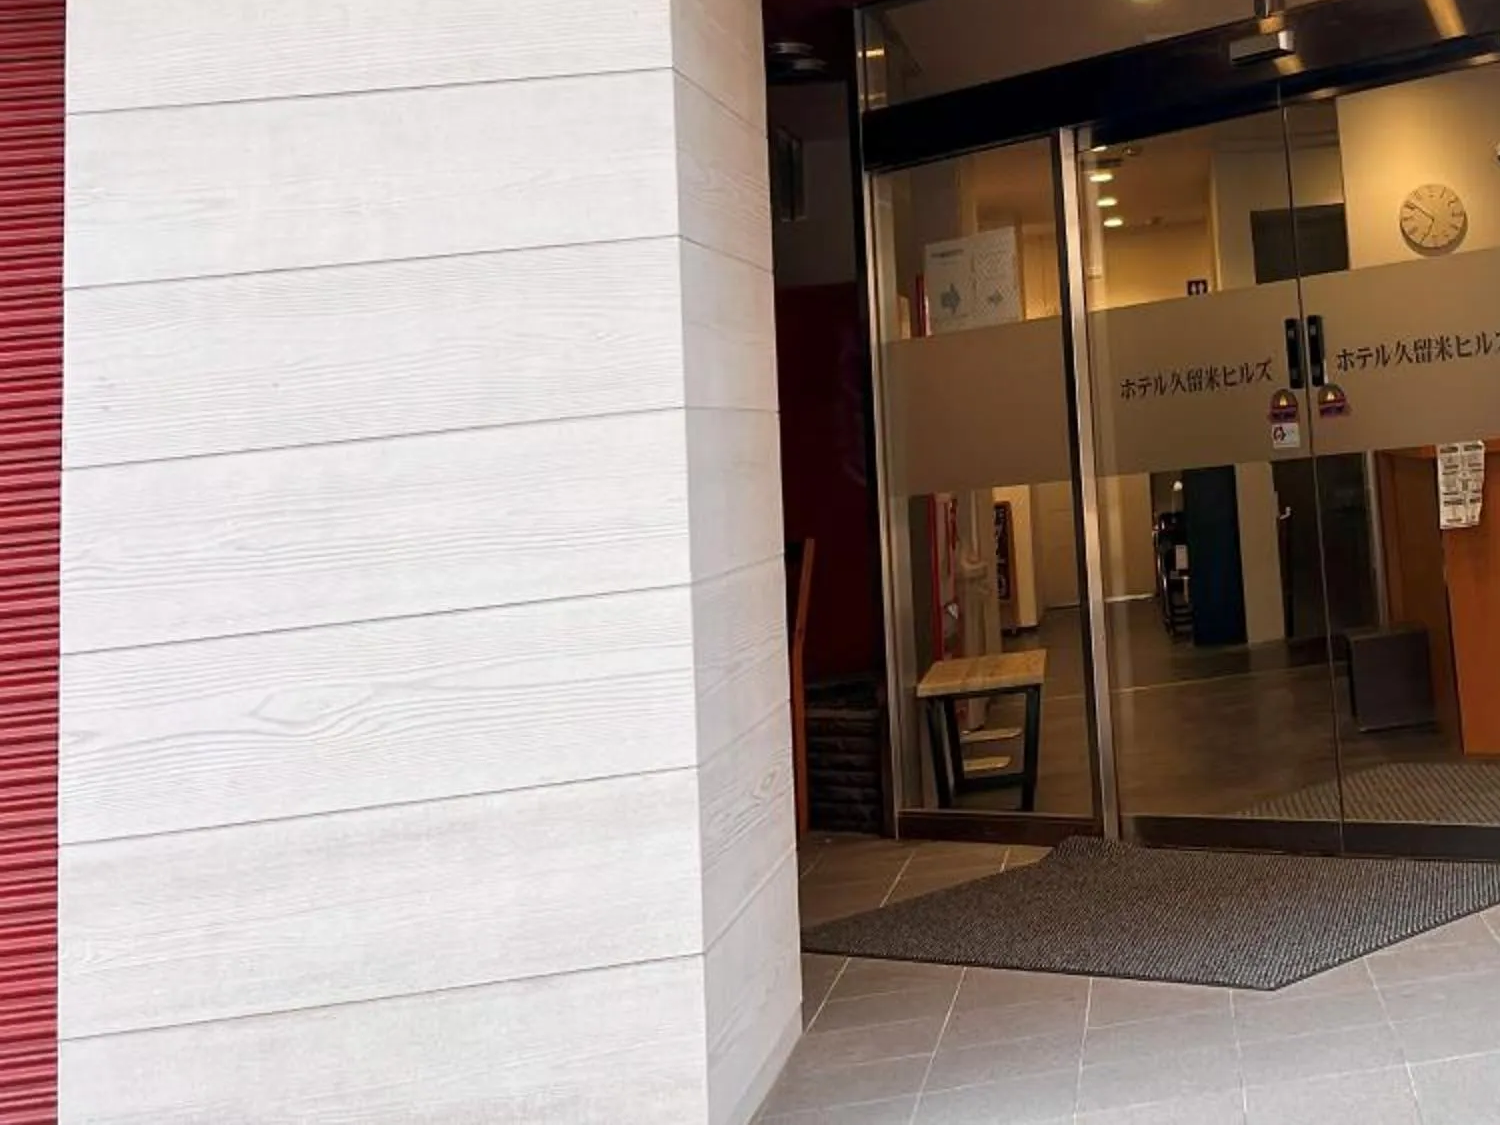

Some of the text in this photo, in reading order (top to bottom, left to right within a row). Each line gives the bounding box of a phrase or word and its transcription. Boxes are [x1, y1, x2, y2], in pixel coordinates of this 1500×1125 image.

[1120, 358, 1273, 400] ホテル久留米ヒルズ
